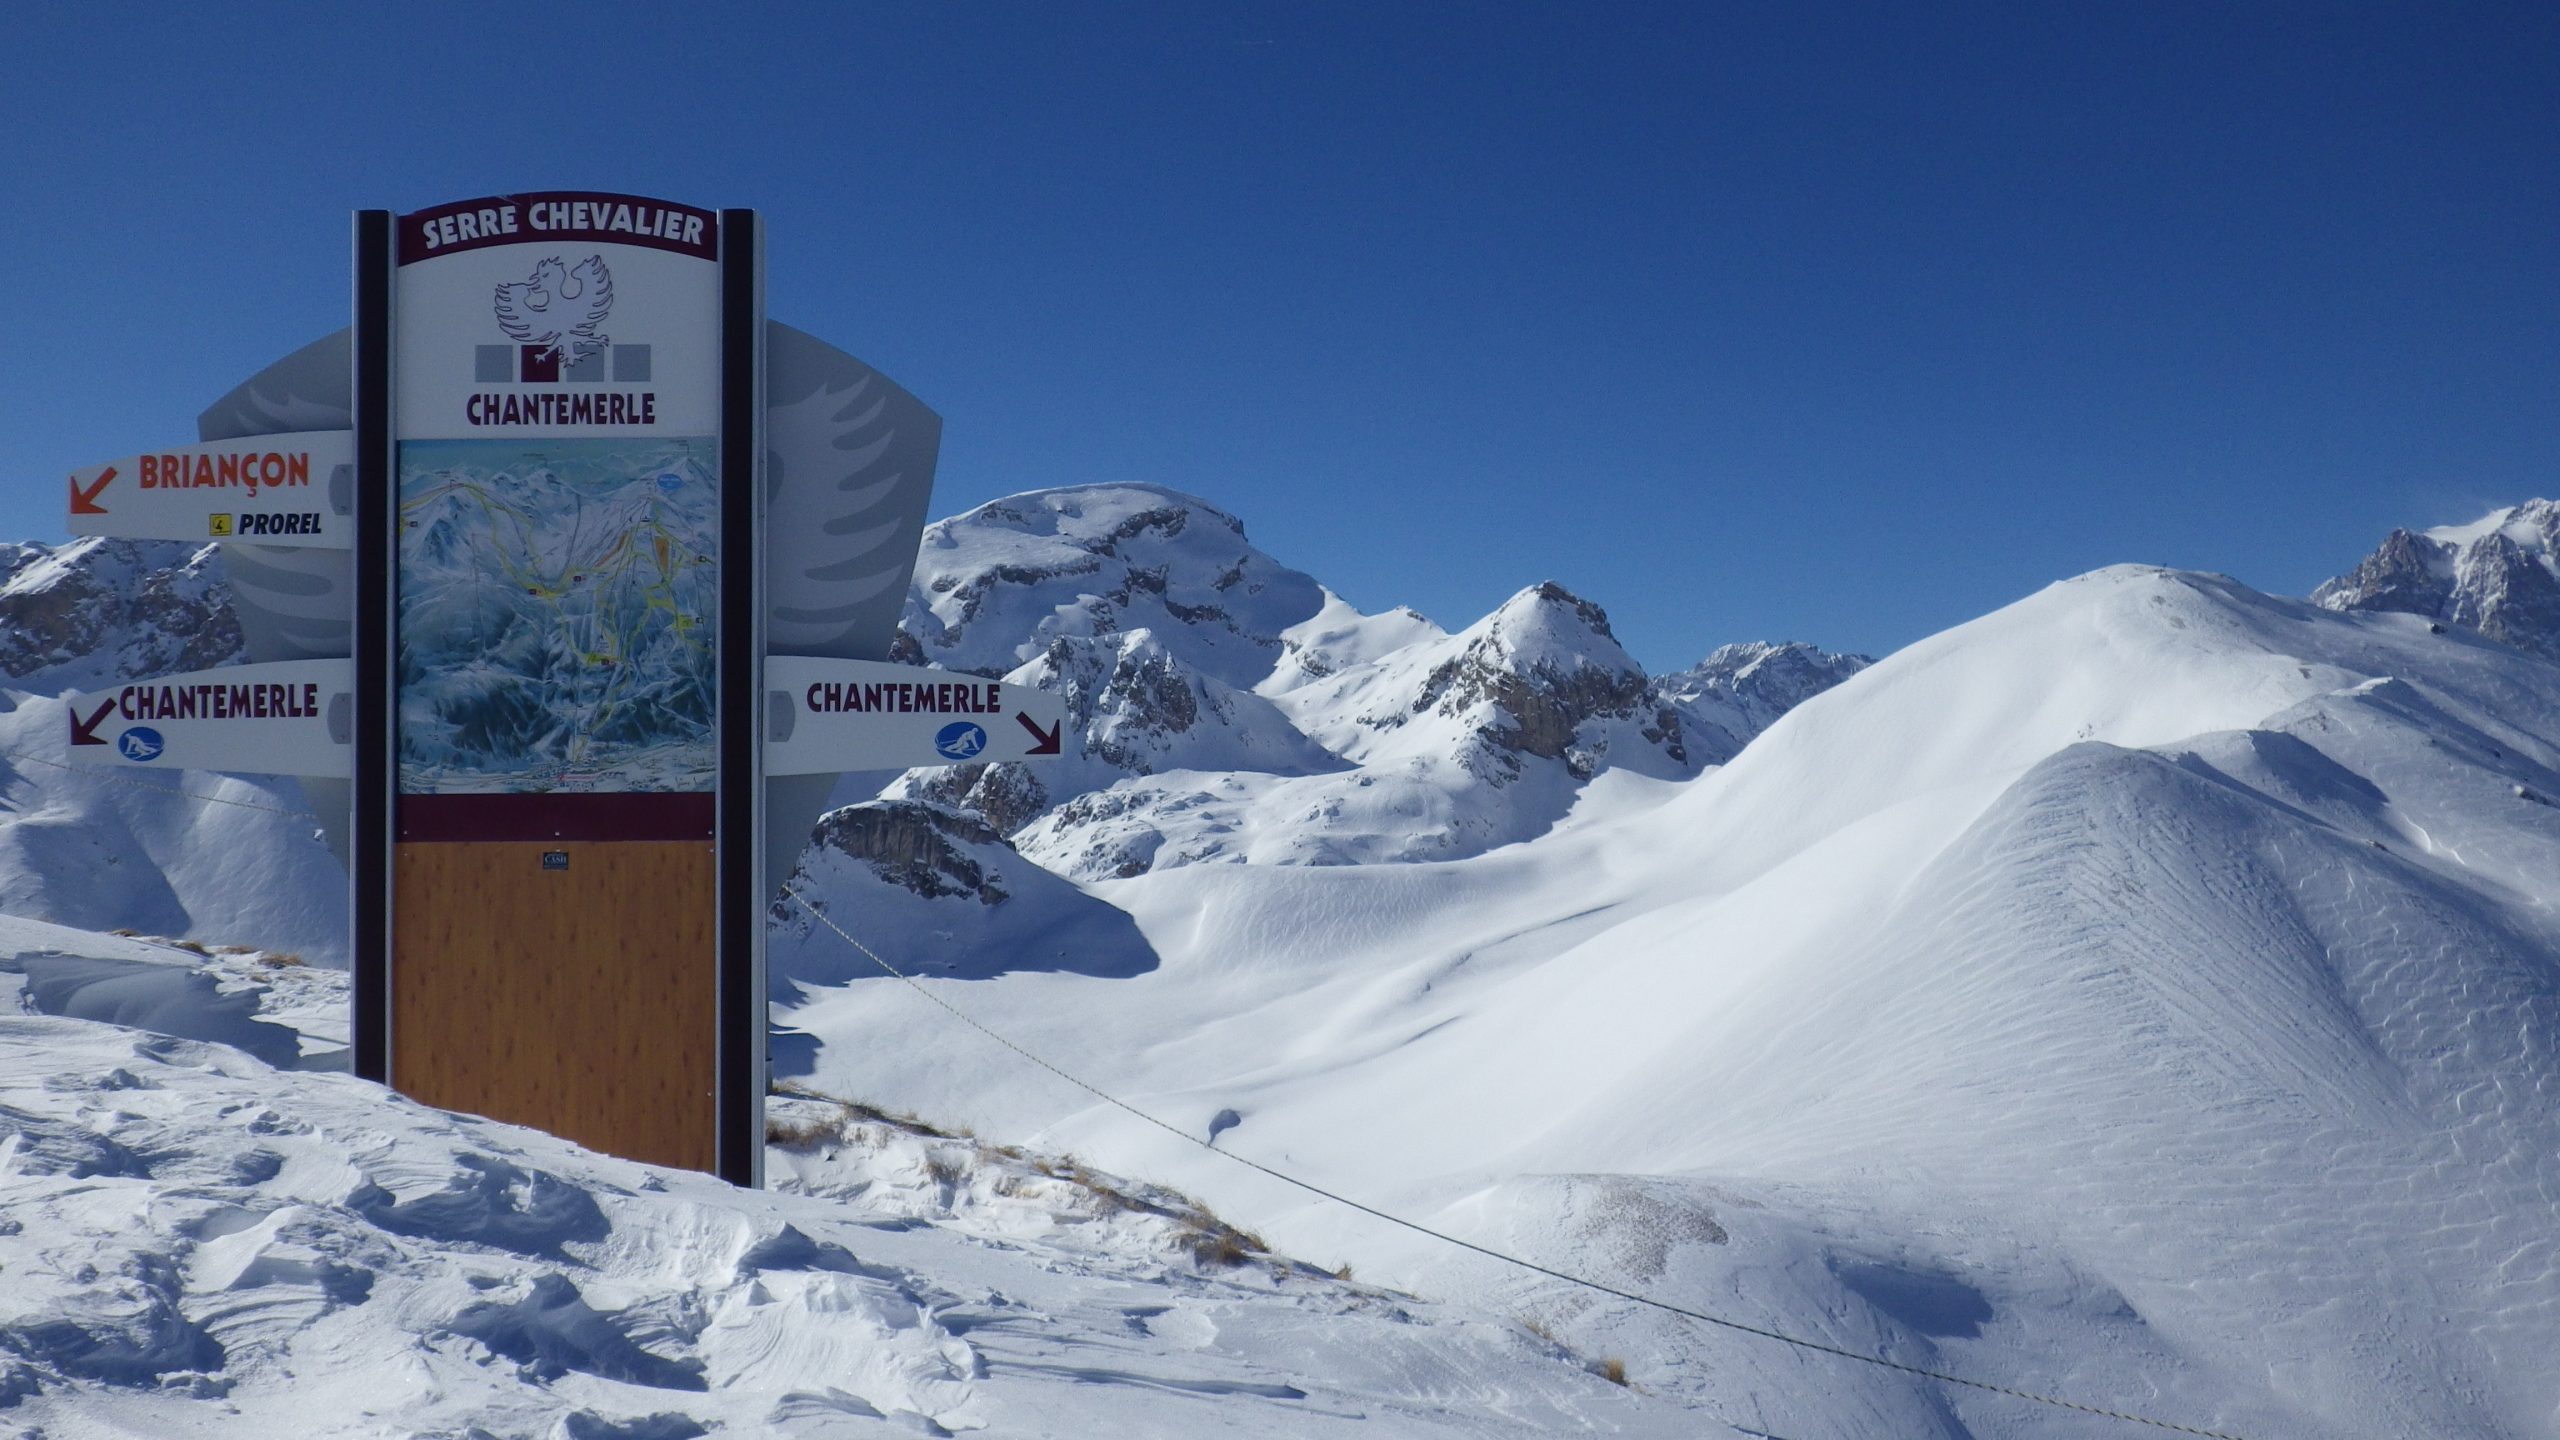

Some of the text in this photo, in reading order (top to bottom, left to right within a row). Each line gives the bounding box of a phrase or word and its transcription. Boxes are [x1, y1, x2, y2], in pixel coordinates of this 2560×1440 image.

[422, 202, 704, 249] SERRE CHEVALIER
[466, 393, 656, 426] CHANTEMERLE
[139, 453, 309, 498] BRIANÇON
[238, 513, 322, 535] PROREL
[119, 683, 318, 721] CHANTEMERLE
[807, 682, 1001, 713] CHANTEMERLE
